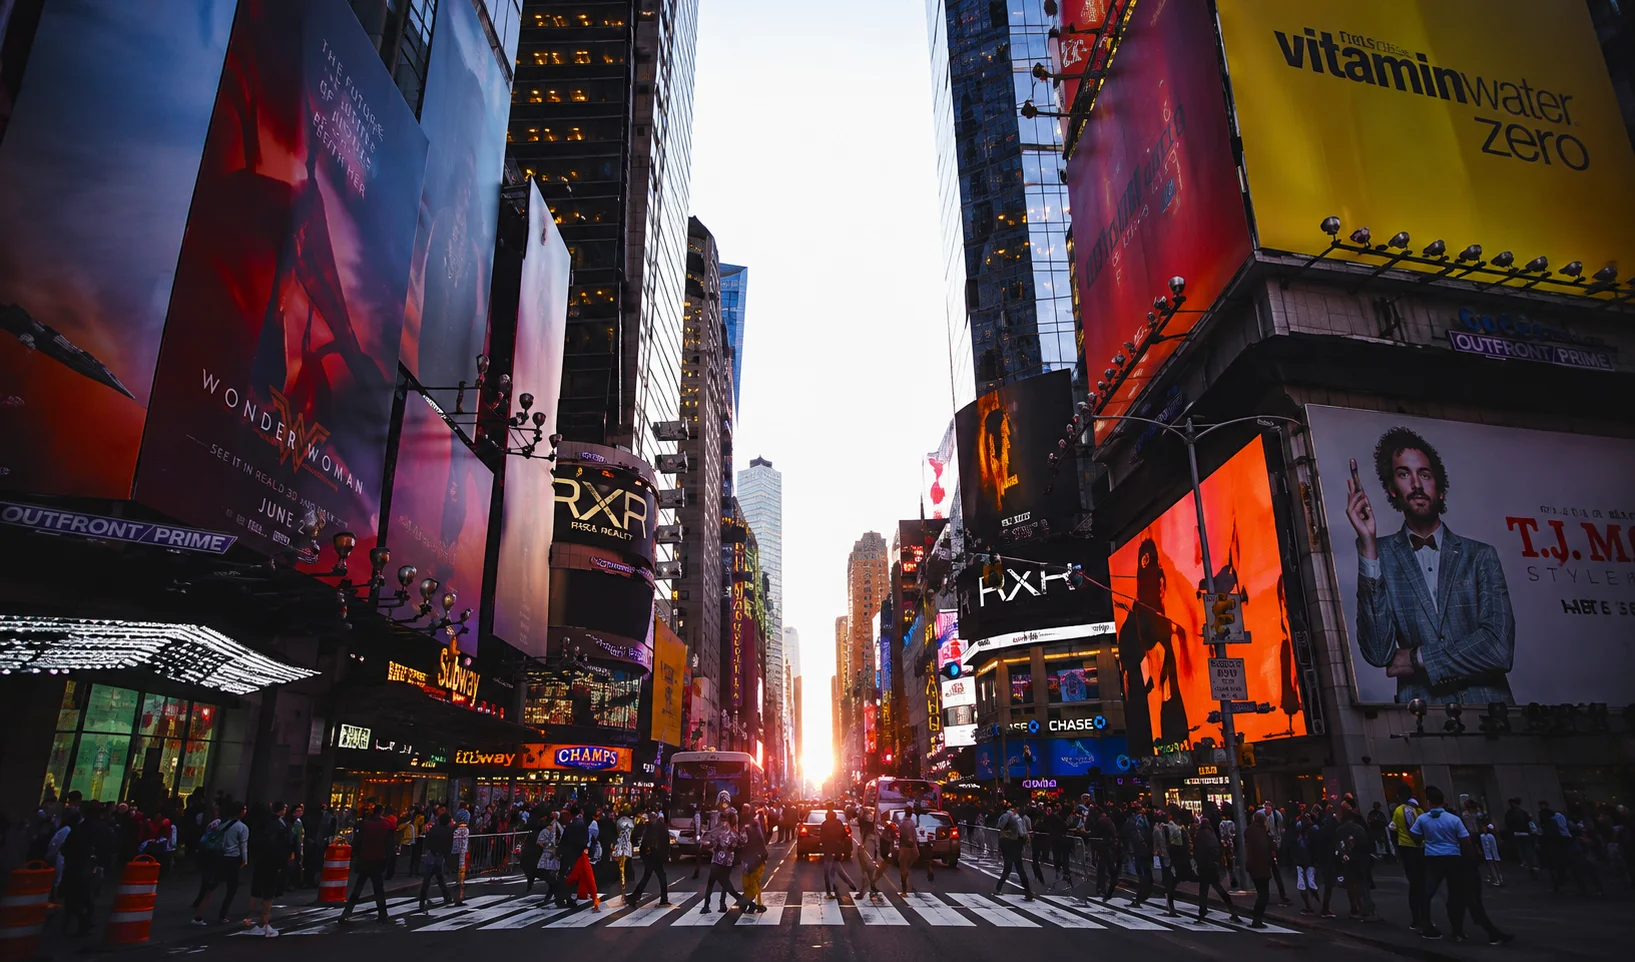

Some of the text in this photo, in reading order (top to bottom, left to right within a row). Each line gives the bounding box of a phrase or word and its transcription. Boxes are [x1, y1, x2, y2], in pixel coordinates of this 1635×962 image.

[321, 38, 344, 77] THE
[1473, 116, 1590, 171] zero
[346, 164, 366, 201] HER
[202, 368, 364, 495] WONDER WOMAN
[209, 443, 230, 462] SEE
[232, 455, 241, 468] IT
[243, 462, 254, 476] IN
[255, 470, 285, 493] REALD
[286, 488, 298, 501] 3D
[258, 497, 294, 528] JUNE
[554, 477, 648, 539] RXR
[437, 647, 481, 708] Subway
[1048, 718, 1094, 732] CHASE
[558, 747, 617, 765] CHAMPS
